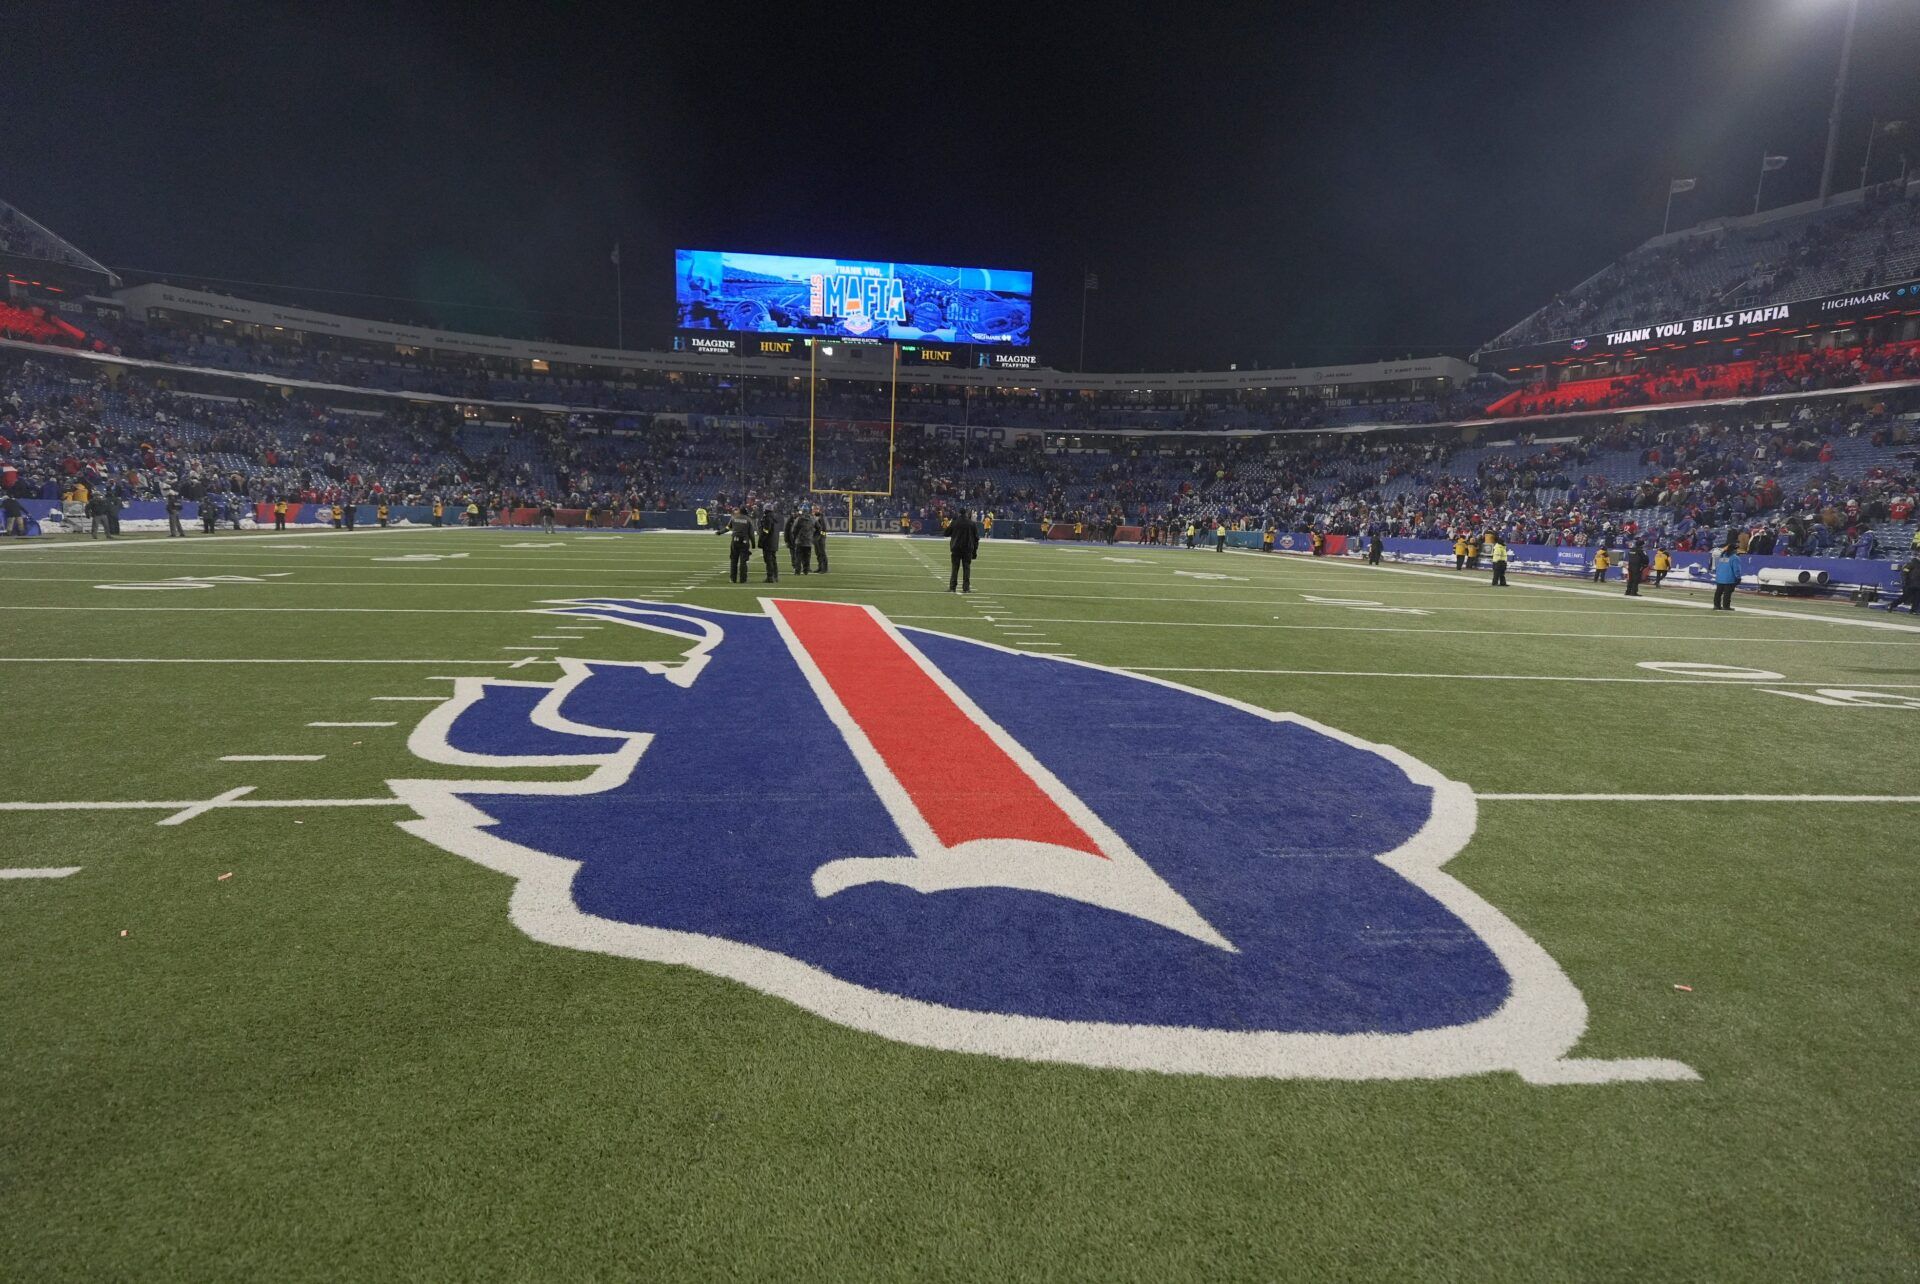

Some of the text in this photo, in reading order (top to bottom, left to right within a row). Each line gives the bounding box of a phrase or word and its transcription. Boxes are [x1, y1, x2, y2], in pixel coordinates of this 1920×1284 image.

[836, 266, 862, 275] THANK
[810, 274, 823, 316] BILLS
[824, 275, 906, 321] MAFIA
[1821, 290, 1892, 311] HIGHMARK
[1606, 305, 1789, 346] THANK YOU, BILLS MAFIA
[692, 338, 736, 349] IMAGINE
[760, 341, 791, 353] HUNT
[921, 350, 952, 361] HUNT
[996, 354, 1037, 364] IMAGINE
[935, 425, 1006, 442] GEICO
[855, 519, 901, 533] BILLS
